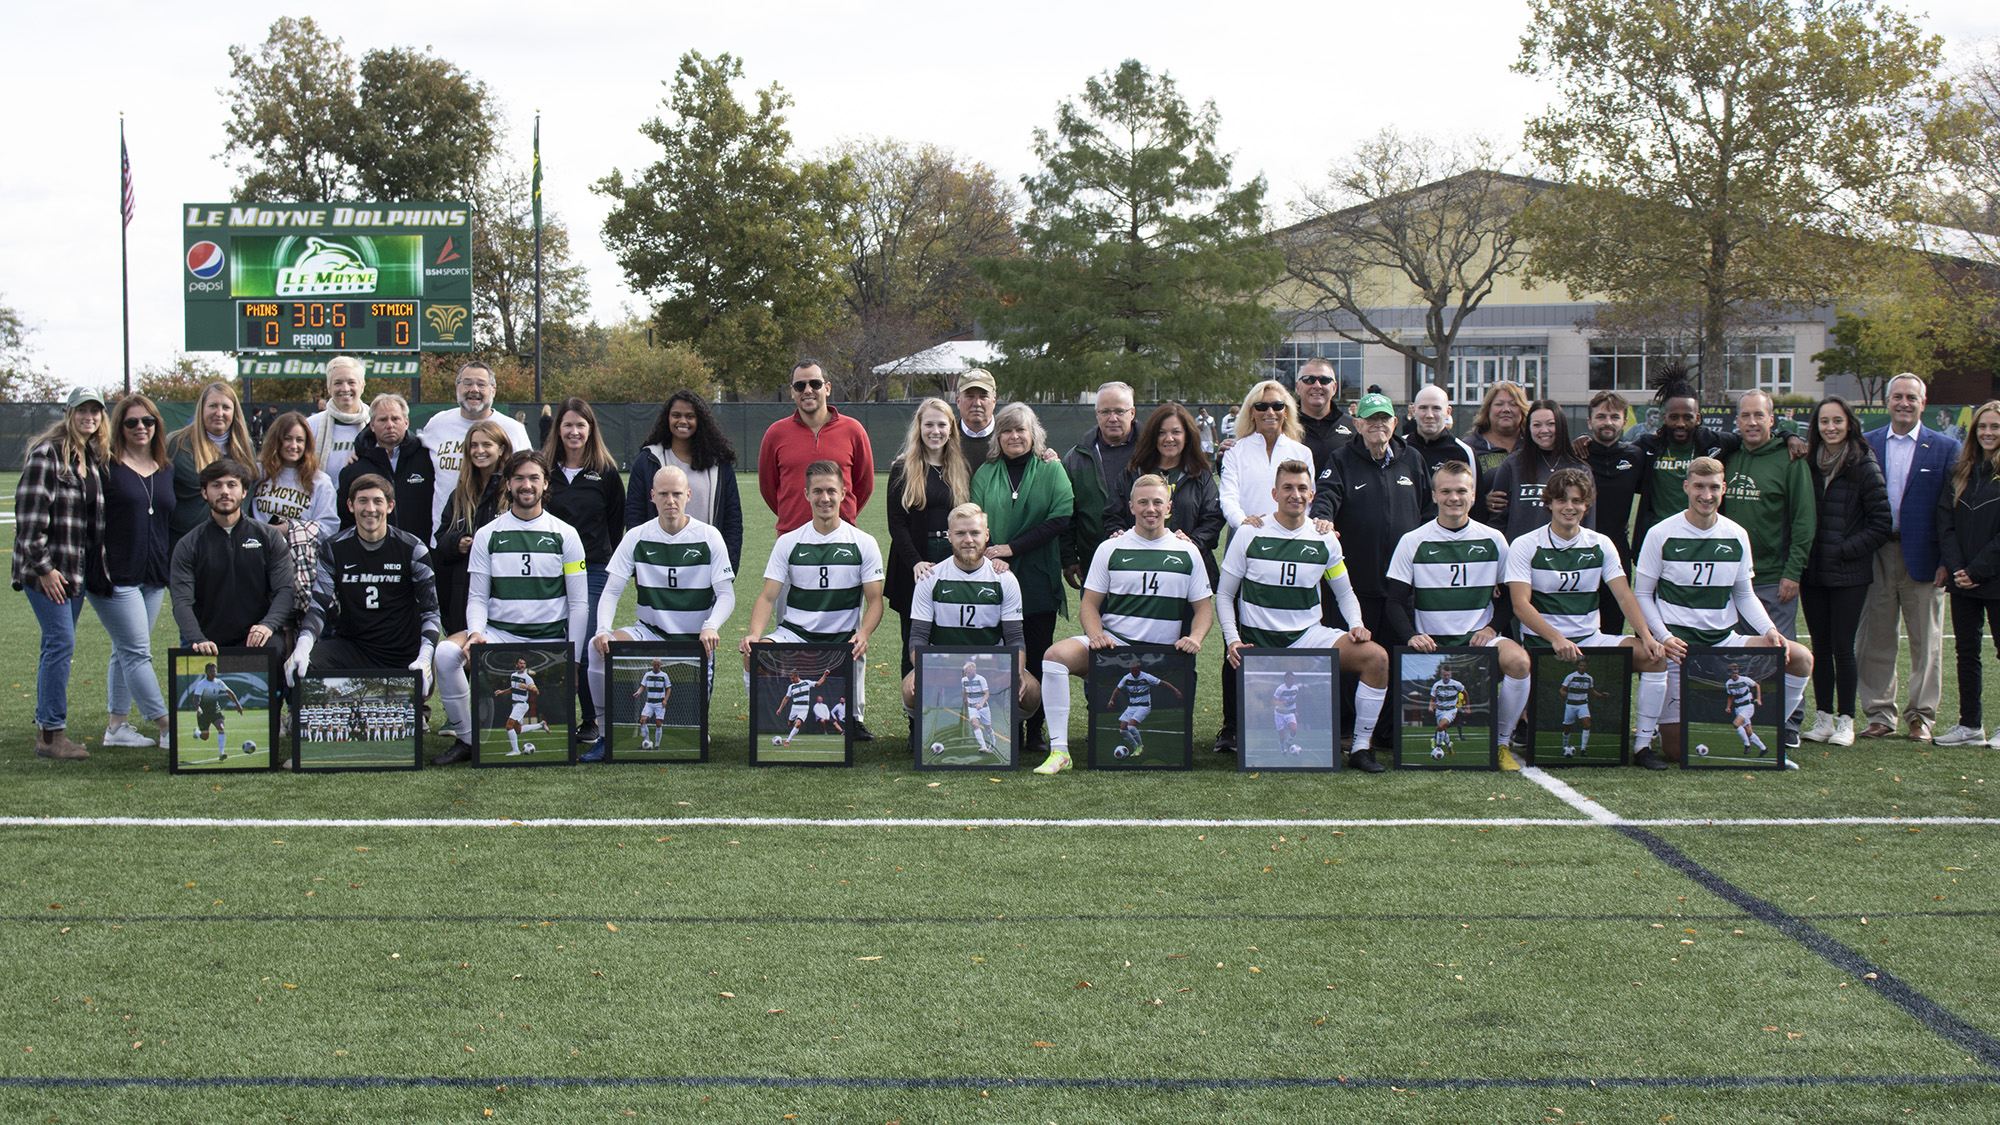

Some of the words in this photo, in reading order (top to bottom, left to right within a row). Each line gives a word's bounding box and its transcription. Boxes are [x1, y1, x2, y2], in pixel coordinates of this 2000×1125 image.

[228, 207, 327, 227] MOYNE
[332, 207, 467, 226] DOLPHINS
[189, 280, 223, 293] pepsi
[315, 272, 377, 284] MOYNE
[283, 285, 376, 293] DOLPHINS
[246, 304, 278, 316] PHINS
[265, 321, 279, 345] 0
[293, 334, 333, 345] PERIOD
[340, 331, 345, 347] 1
[395, 321, 409, 345] 0
[240, 359, 282, 374] TED
[283, 359, 327, 374] GRA
[1653, 460, 1690, 470] DOLPH
[256, 499, 303, 520] COLLEGE
[521, 554, 531, 575] 3
[1280, 563, 1297, 585] 19
[1450, 564, 1467, 586] 21
[1692, 563, 1715, 585] 27
[360, 573, 401, 583] MOYNE
[668, 568, 678, 588] 6
[819, 566, 829, 588] 8
[1142, 572, 1159, 594] 14
[1558, 571, 1580, 592] 22
[365, 586, 379, 609] 2
[960, 605, 976, 627] 12
